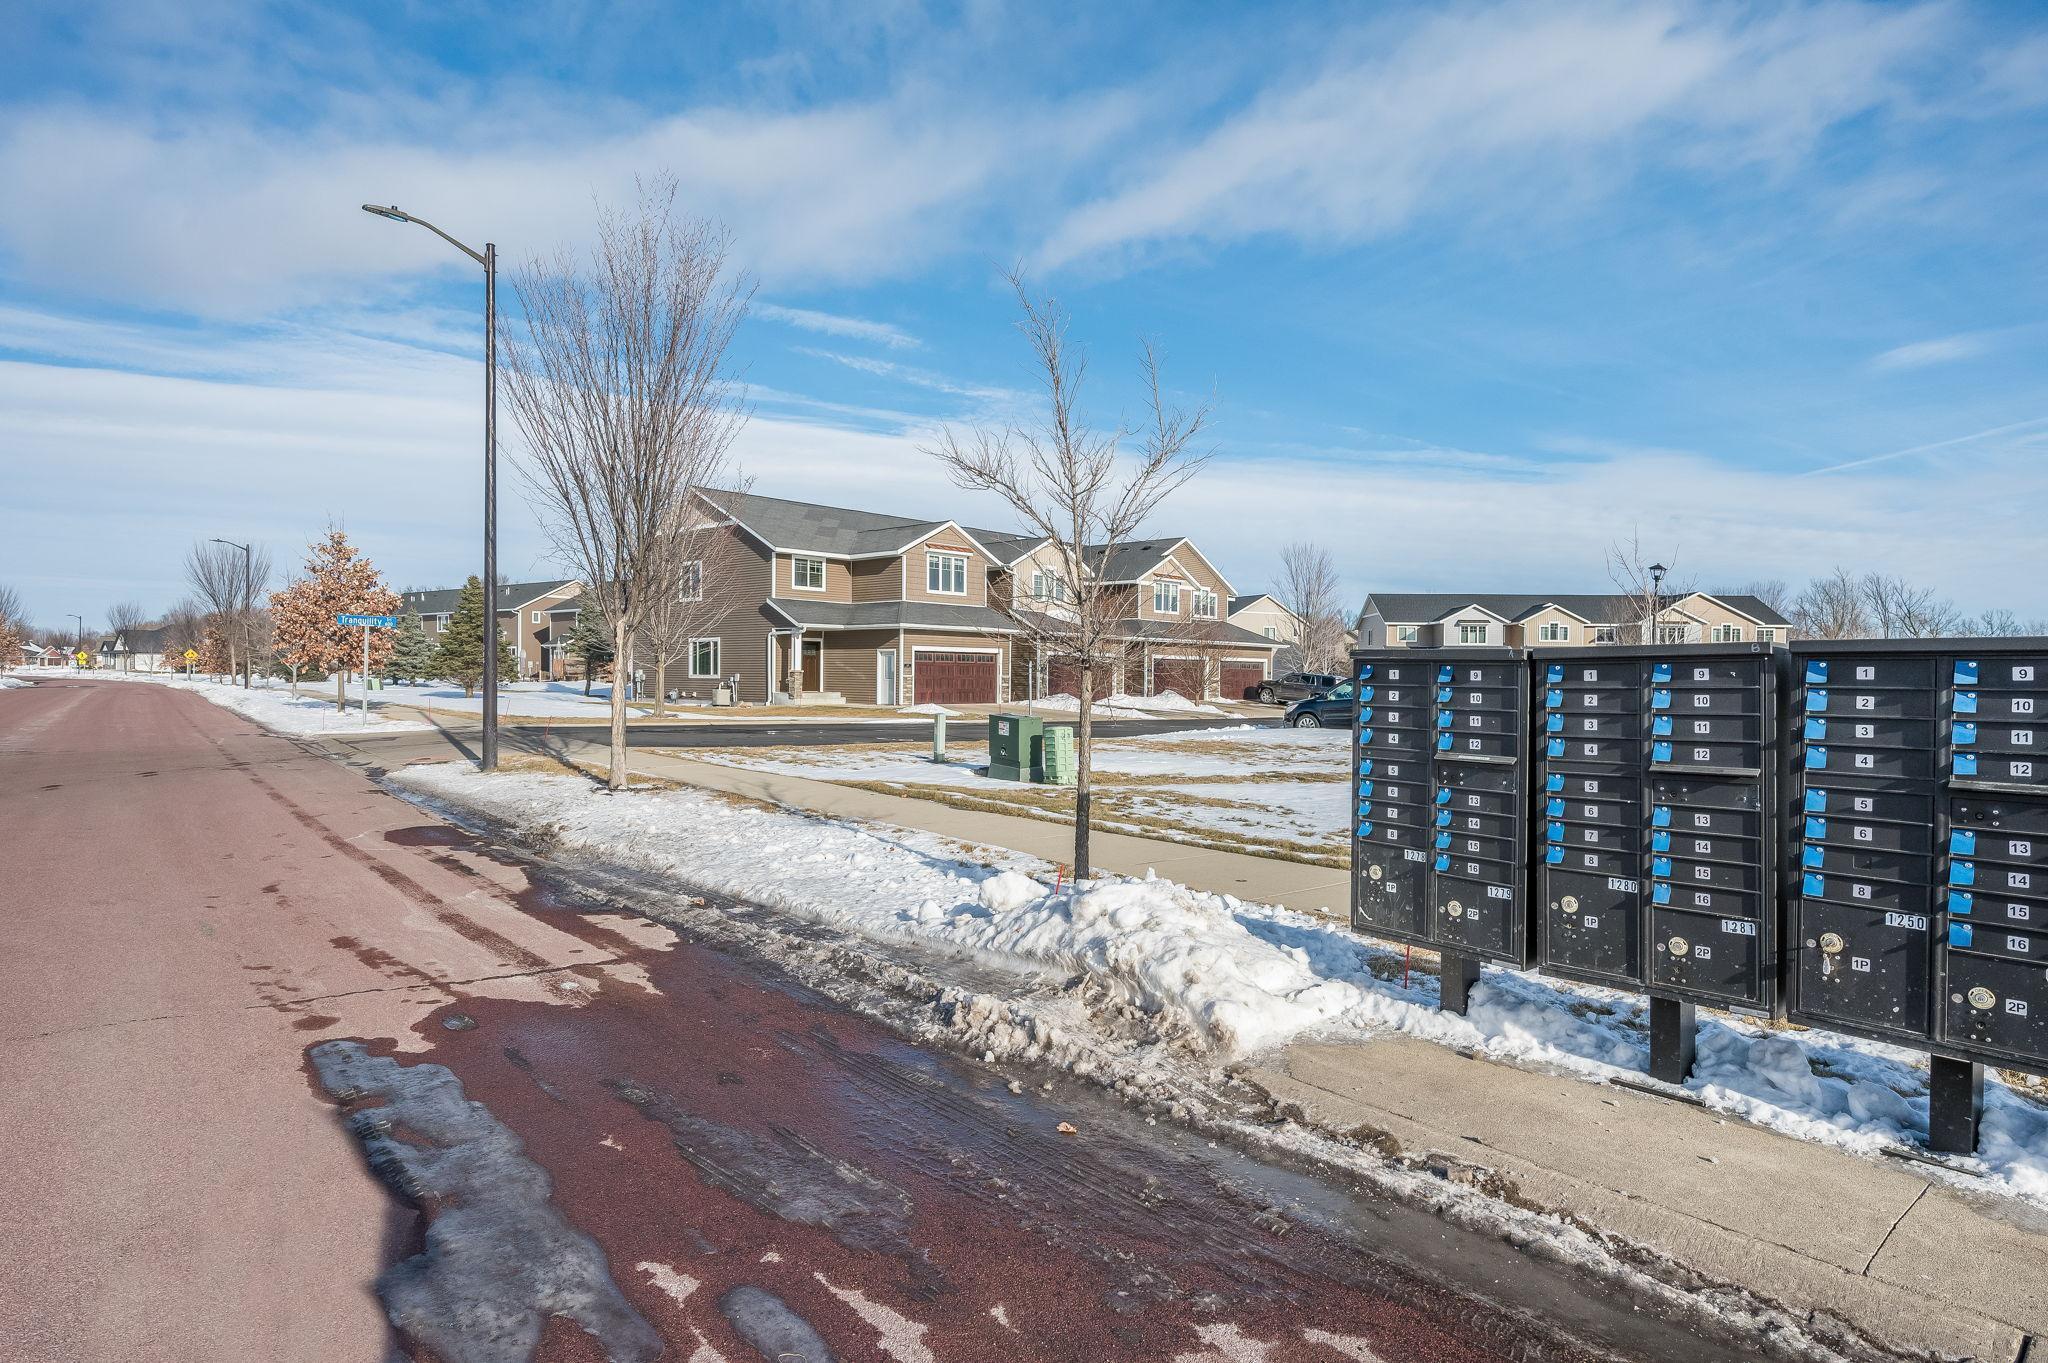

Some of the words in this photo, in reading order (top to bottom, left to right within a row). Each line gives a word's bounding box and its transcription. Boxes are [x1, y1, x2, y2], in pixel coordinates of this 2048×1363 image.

[341, 616, 382, 626] Tranquility
[1472, 694, 1481, 703] 10
[1696, 696, 1709, 705] 10
[2014, 700, 2031, 711] 10
[1471, 717, 1479, 725] 11
[1696, 723, 1707, 732] 11
[2014, 732, 2029, 743] 11
[1470, 740, 1480, 748] 12
[1695, 750, 1708, 759] 12
[2012, 764, 2030, 775] 12
[1470, 796, 1479, 805] 13
[1469, 819, 1479, 827] 14
[1696, 815, 1709, 825] 13
[1469, 842, 1479, 850] 15
[1696, 842, 1709, 852] 14
[2010, 843, 2029, 854] 13
[1468, 864, 1478, 873] 16
[1696, 868, 1709, 878] 15
[1610, 878, 1637, 892] 1280
[2010, 874, 2028, 886] 14
[1387, 883, 1396, 892] 1P
[1489, 887, 1511, 899] 1279
[1696, 894, 1709, 905] 16
[1468, 910, 1478, 918] 2P
[2009, 906, 2027, 918] 15
[1585, 917, 1597, 926] 1P
[1888, 913, 1925, 930] 1250
[1724, 921, 1754, 935] 1281
[2009, 938, 2027, 950] 16
[1696, 947, 1710, 957] 2P
[1853, 959, 1869, 970] 1P
[2007, 1001, 2027, 1013] 2P
